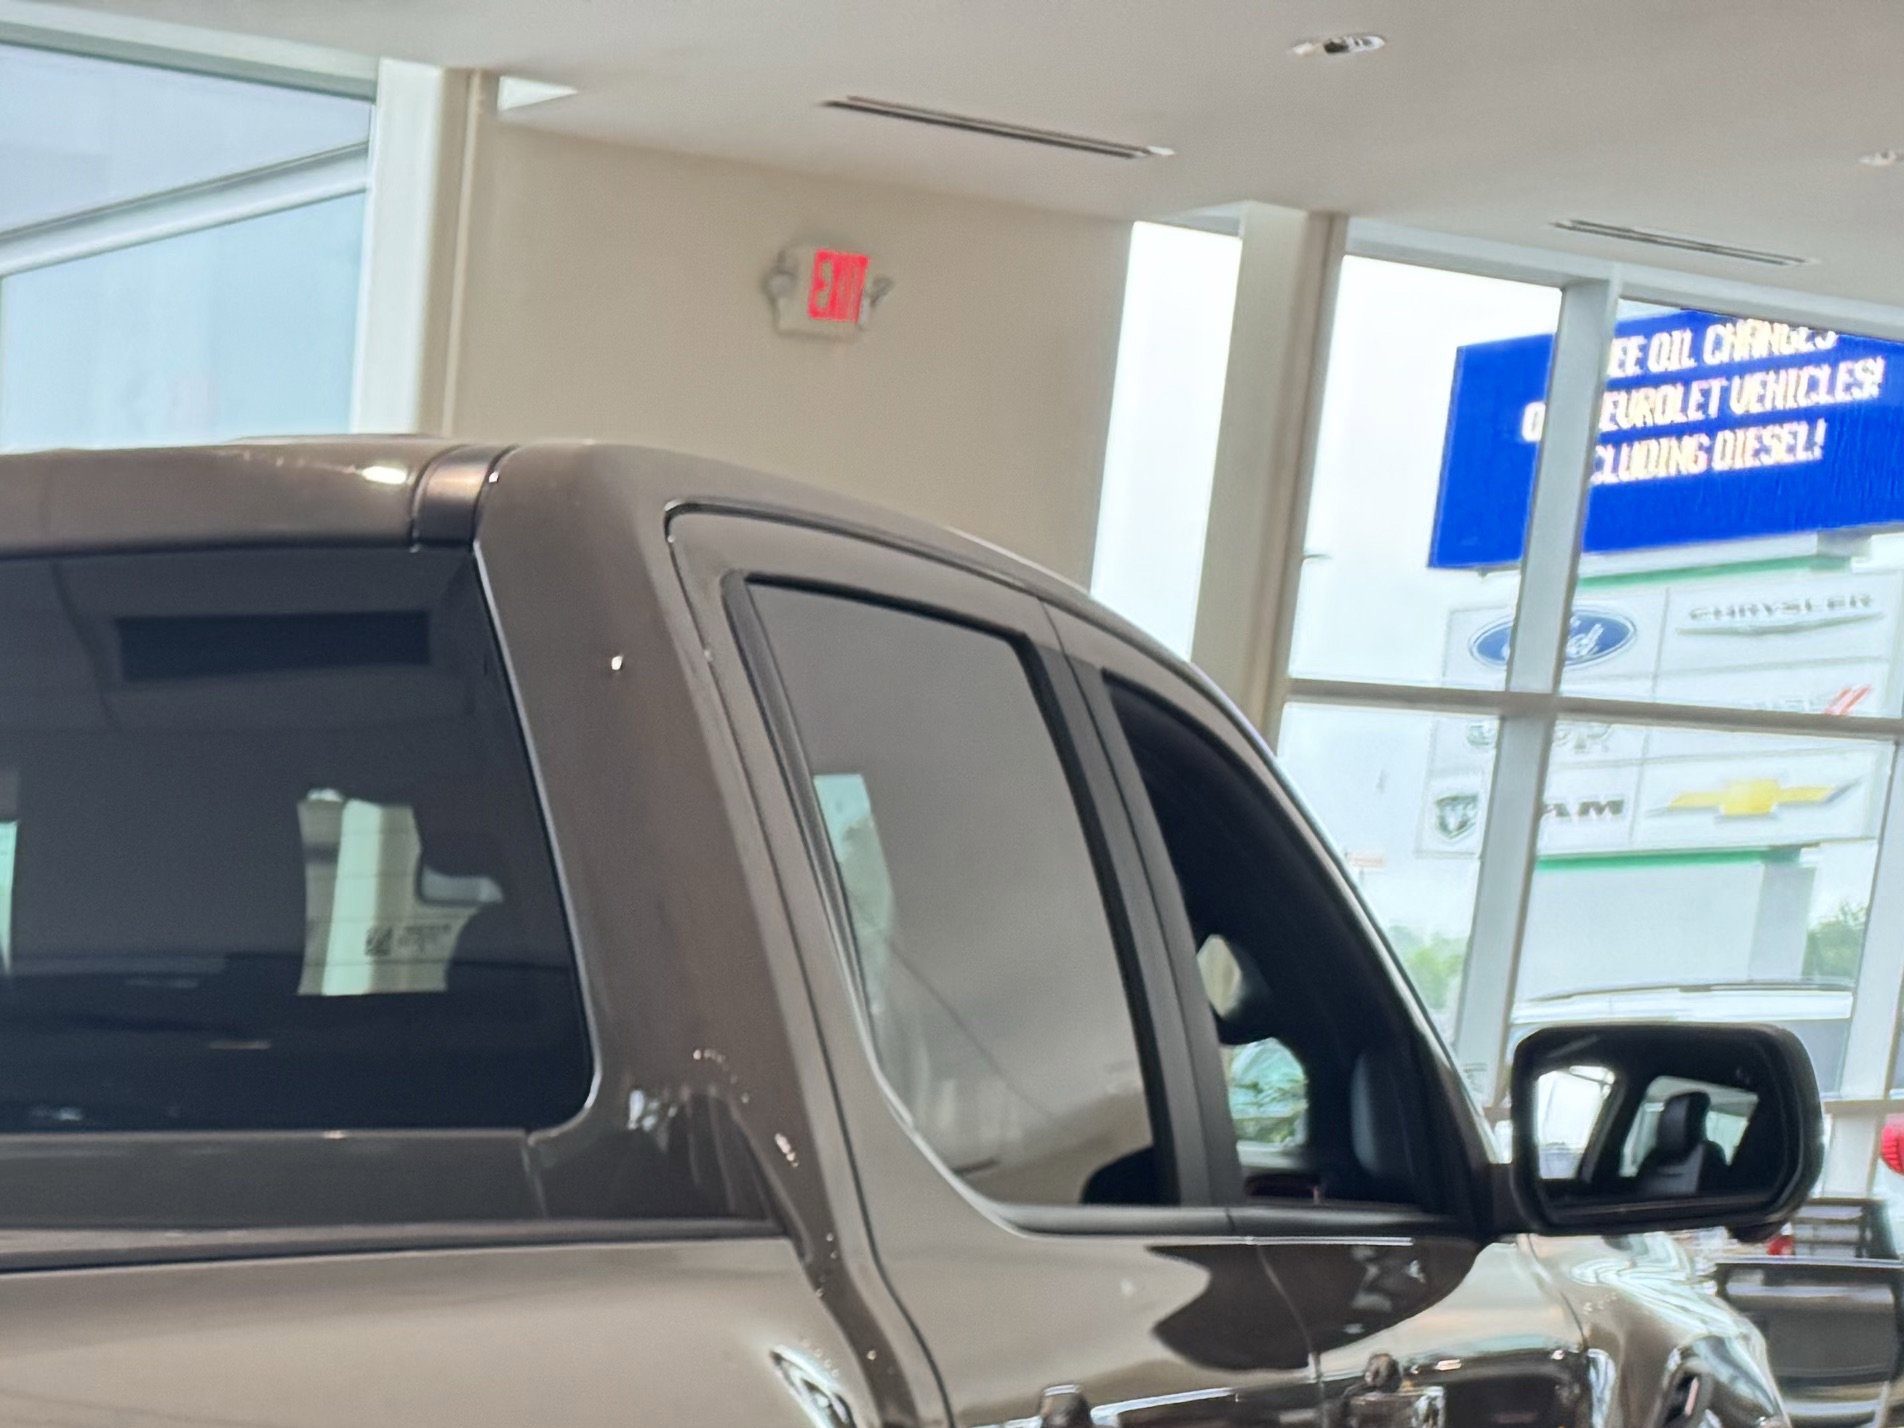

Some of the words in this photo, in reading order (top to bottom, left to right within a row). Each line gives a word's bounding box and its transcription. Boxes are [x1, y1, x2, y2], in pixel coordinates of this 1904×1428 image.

[1608, 335, 1647, 377] EE
[1648, 328, 1697, 372] OIL
[1599, 377, 1729, 433] EVROLET
[1712, 417, 1828, 471] DIESEL!
[1542, 798, 1625, 818] AM
